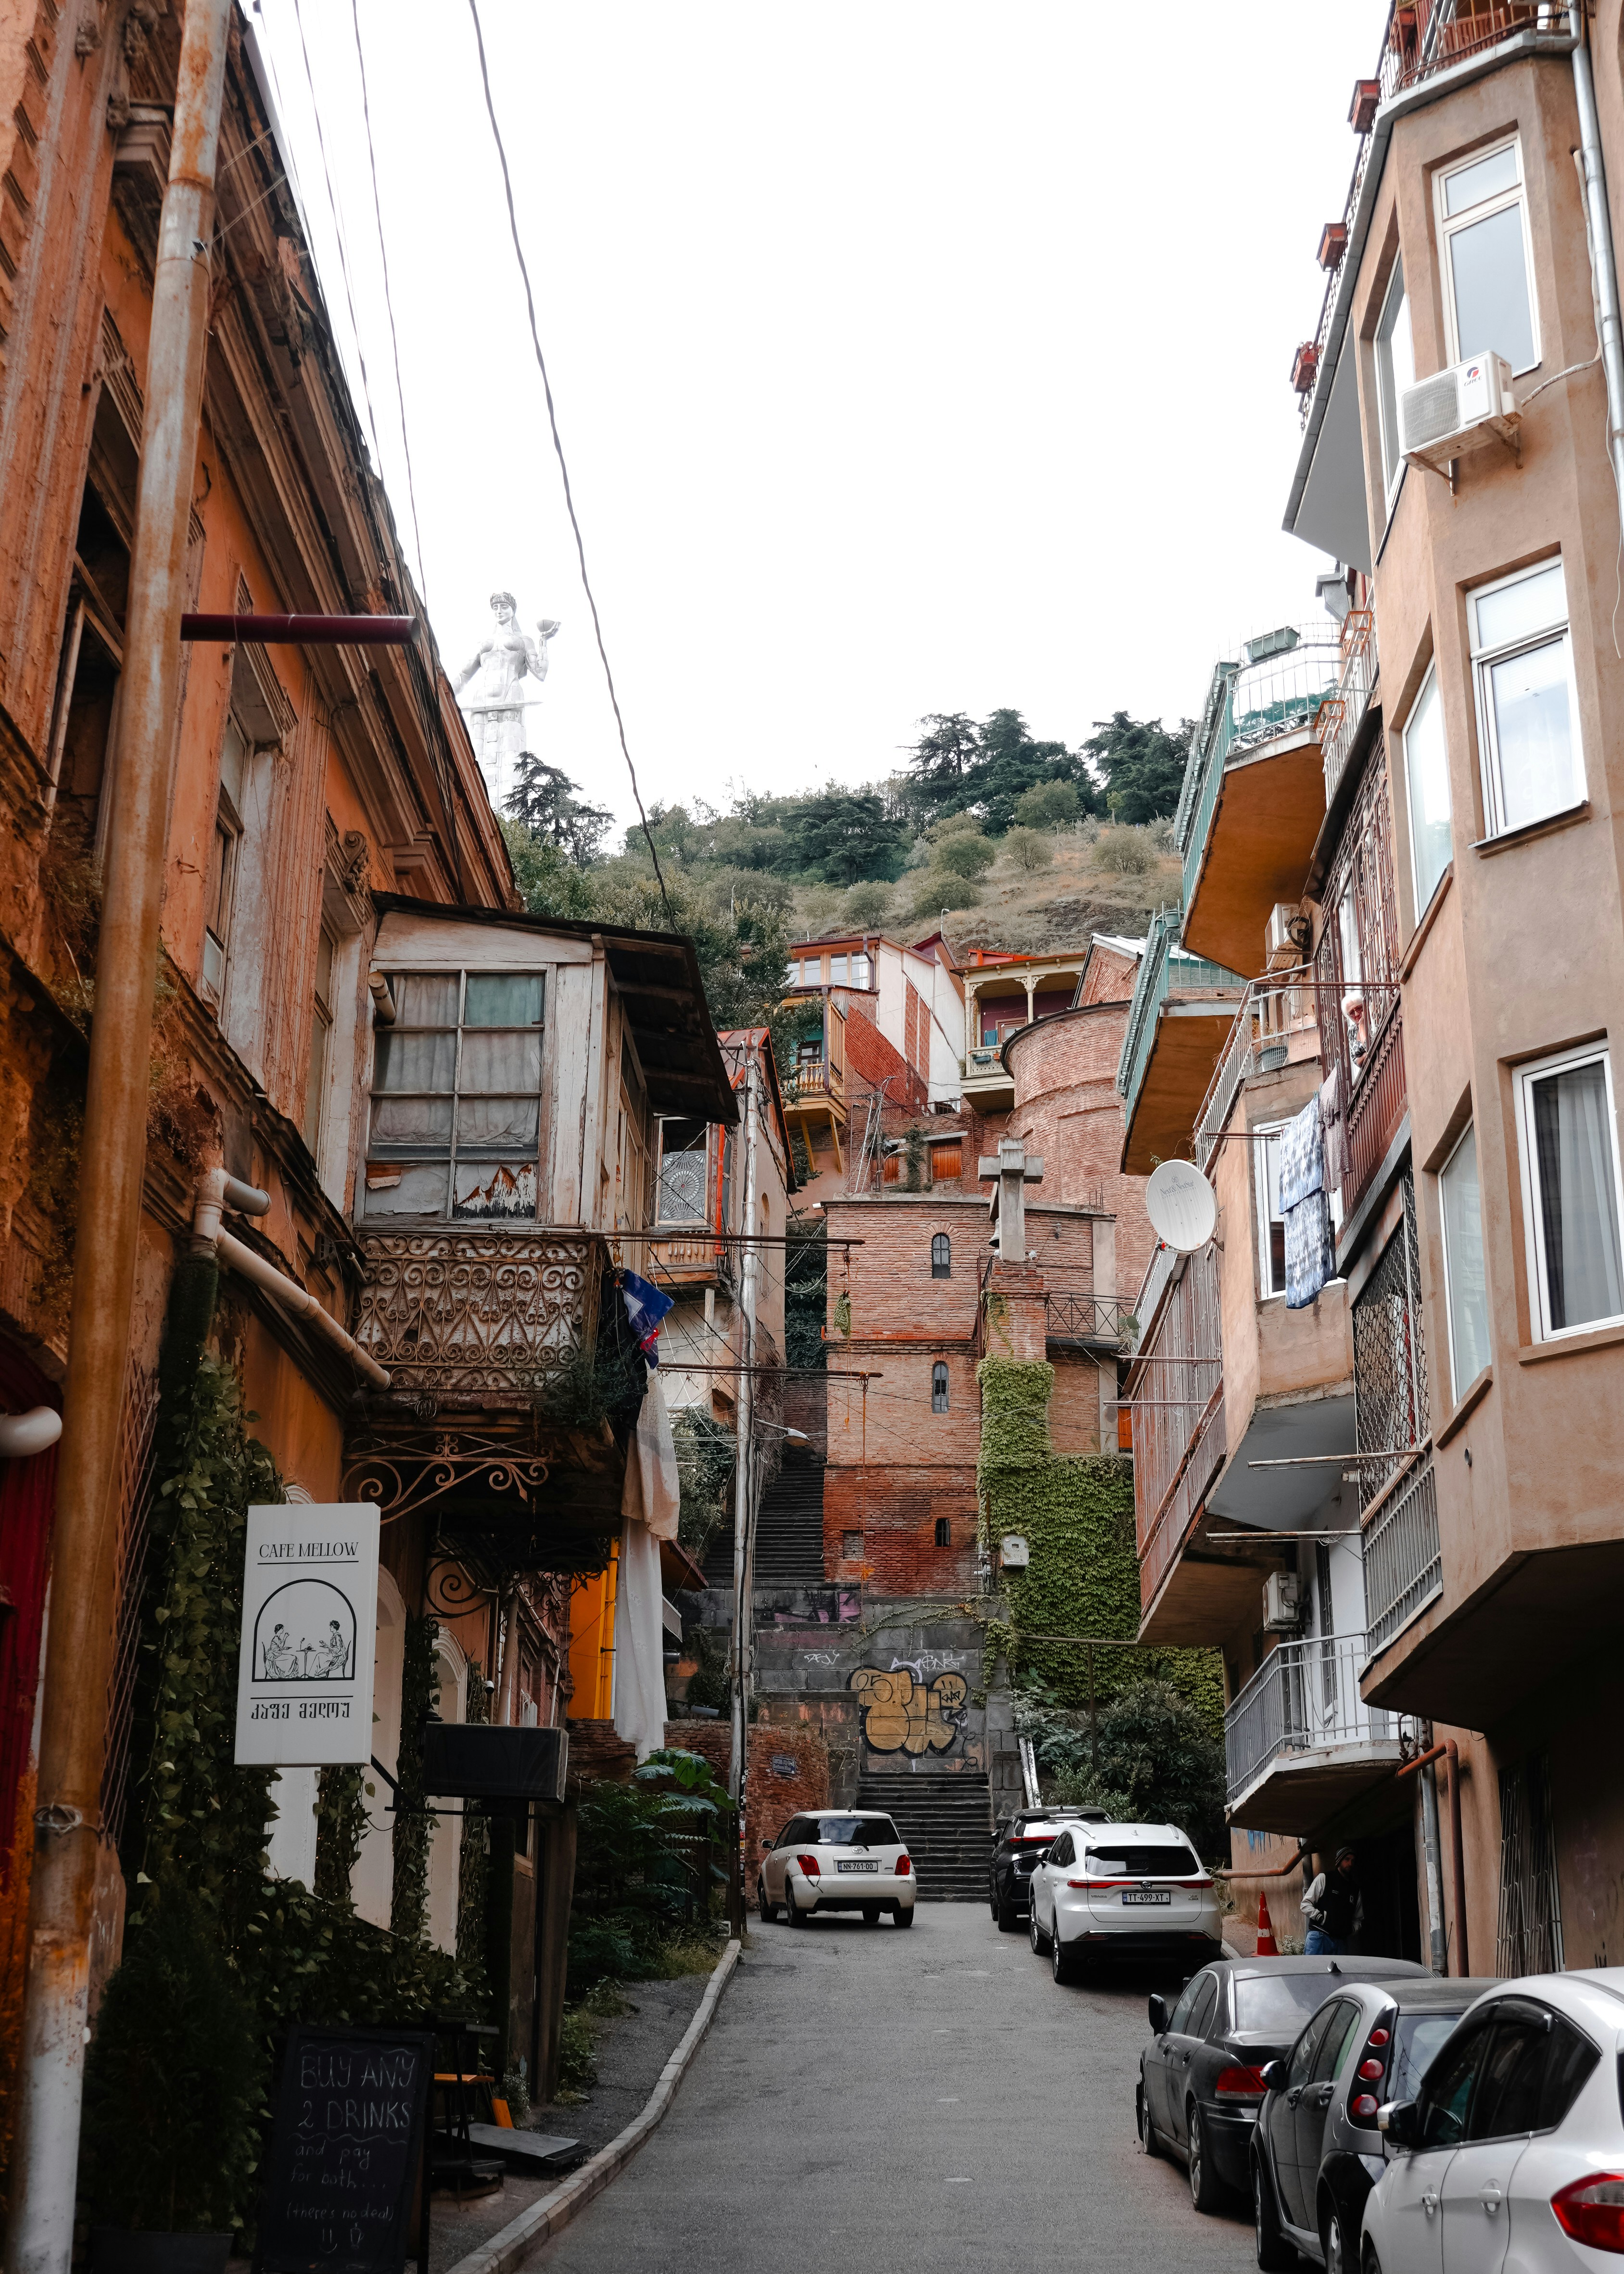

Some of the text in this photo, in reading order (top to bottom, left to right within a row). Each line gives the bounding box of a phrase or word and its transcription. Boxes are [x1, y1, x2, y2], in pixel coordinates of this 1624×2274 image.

[1464, 375, 1482, 387] GREE
[259, 1542, 359, 1558] CAFE MELLOW
[251, 1702, 350, 1720] კაფე მელოუ
[1128, 1893, 1164, 1902] TT-499-XT
[301, 2055, 415, 2089] BUY ANY
[298, 2099, 412, 2130] 2 DRINKS
[295, 2139, 370, 2170] and pay
[291, 2163, 312, 2182] for
[287, 2201, 394, 2222] (there's no deal)
